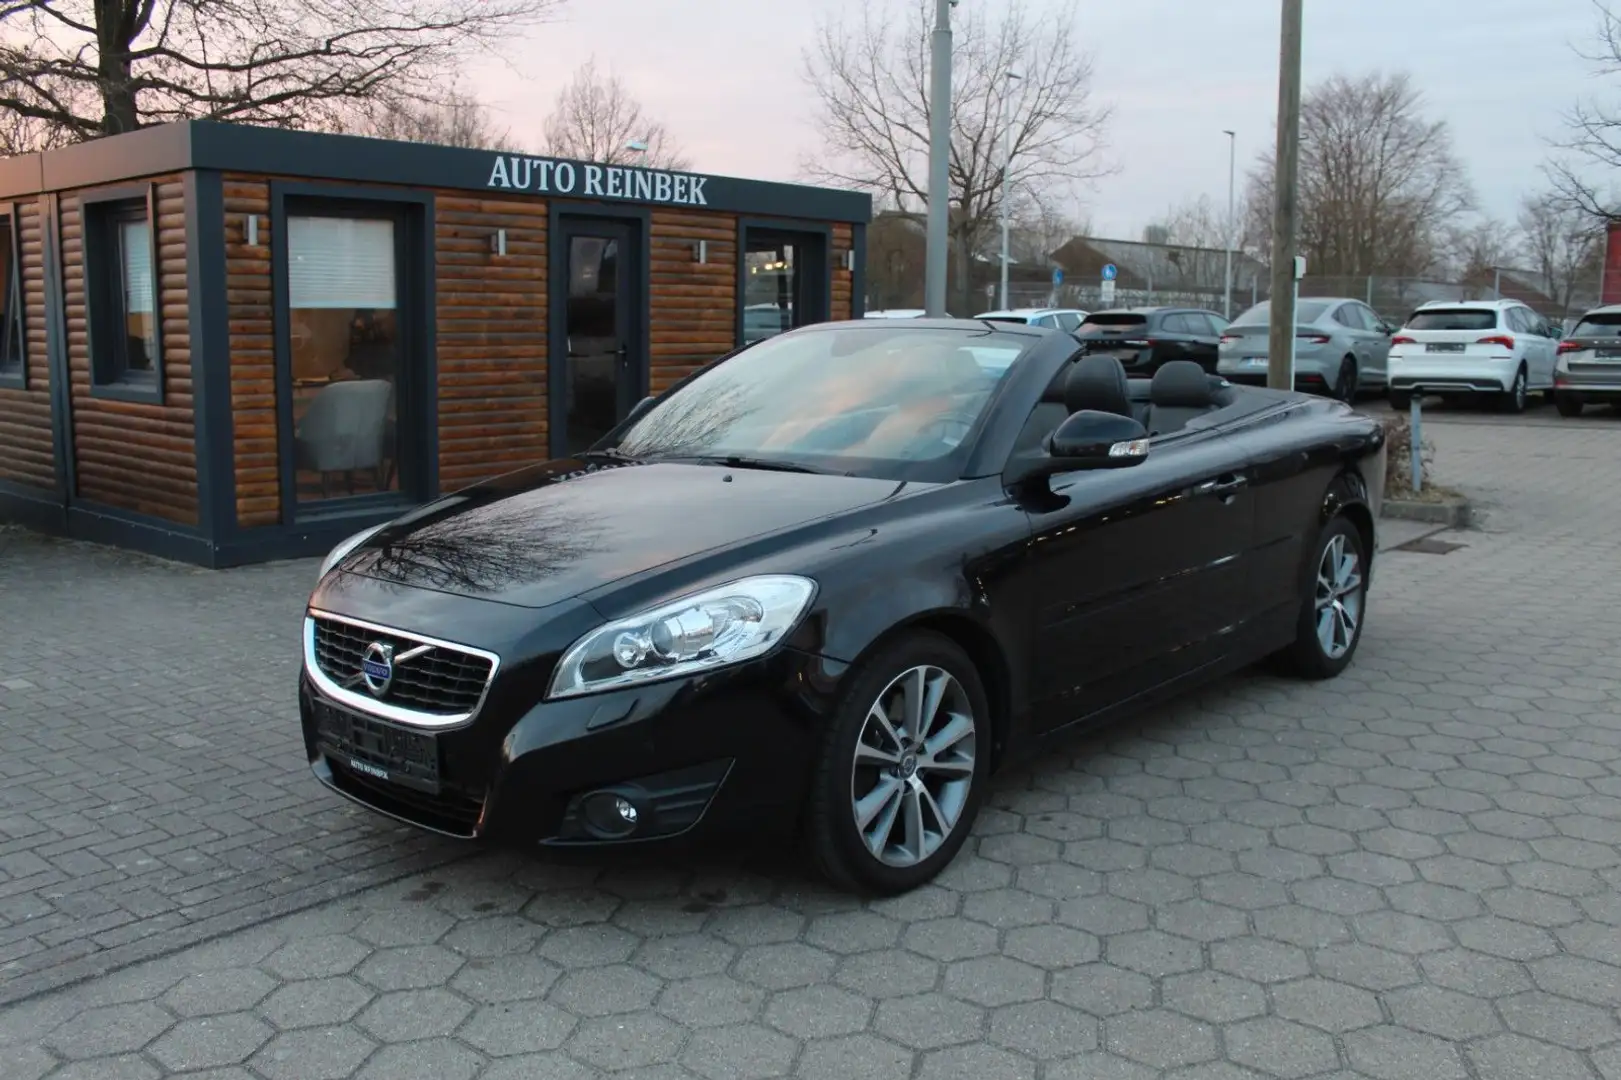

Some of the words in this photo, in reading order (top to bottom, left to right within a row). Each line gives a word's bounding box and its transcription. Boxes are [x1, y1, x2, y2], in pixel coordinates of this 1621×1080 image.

[488, 156, 575, 193] AUTO
[584, 165, 708, 205] REINBEK
[364, 662, 388, 677] VOLVO
